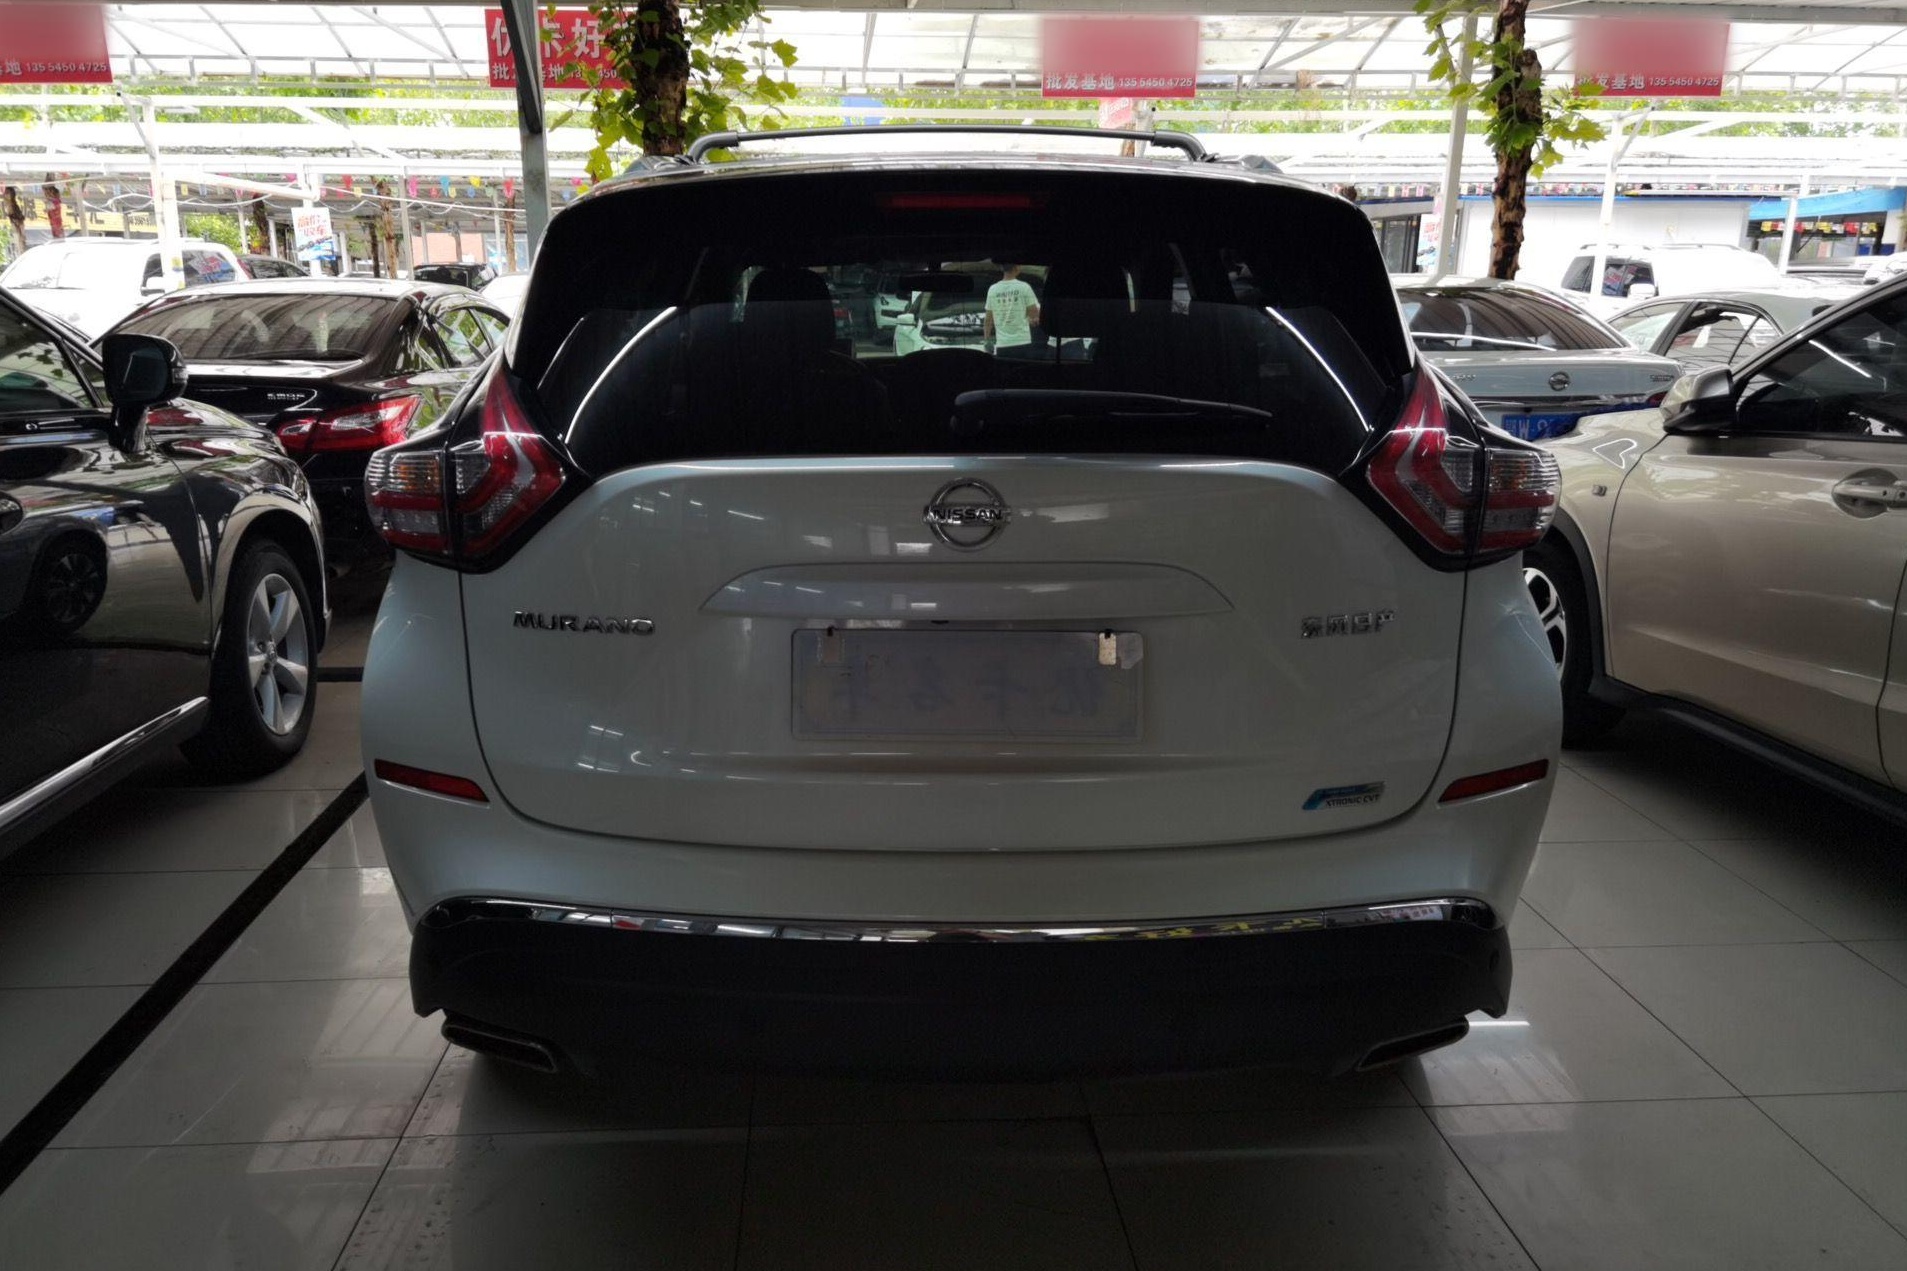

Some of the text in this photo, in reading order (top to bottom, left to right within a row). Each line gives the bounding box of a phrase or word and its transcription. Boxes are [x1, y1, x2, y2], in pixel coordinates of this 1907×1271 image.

[0, 58, 107, 75] 地 135 5450 4725
[1046, 72, 1193, 90] 批发基地 135 5450 4725
[1648, 77, 1667, 86] 135
[1668, 77, 1694, 86] 5450
[1694, 77, 1720, 86] 4725
[933, 508, 1002, 520] NISSAN
[513, 611, 655, 636] MURANO
[1325, 794, 1381, 807] XTRONIC CVT
